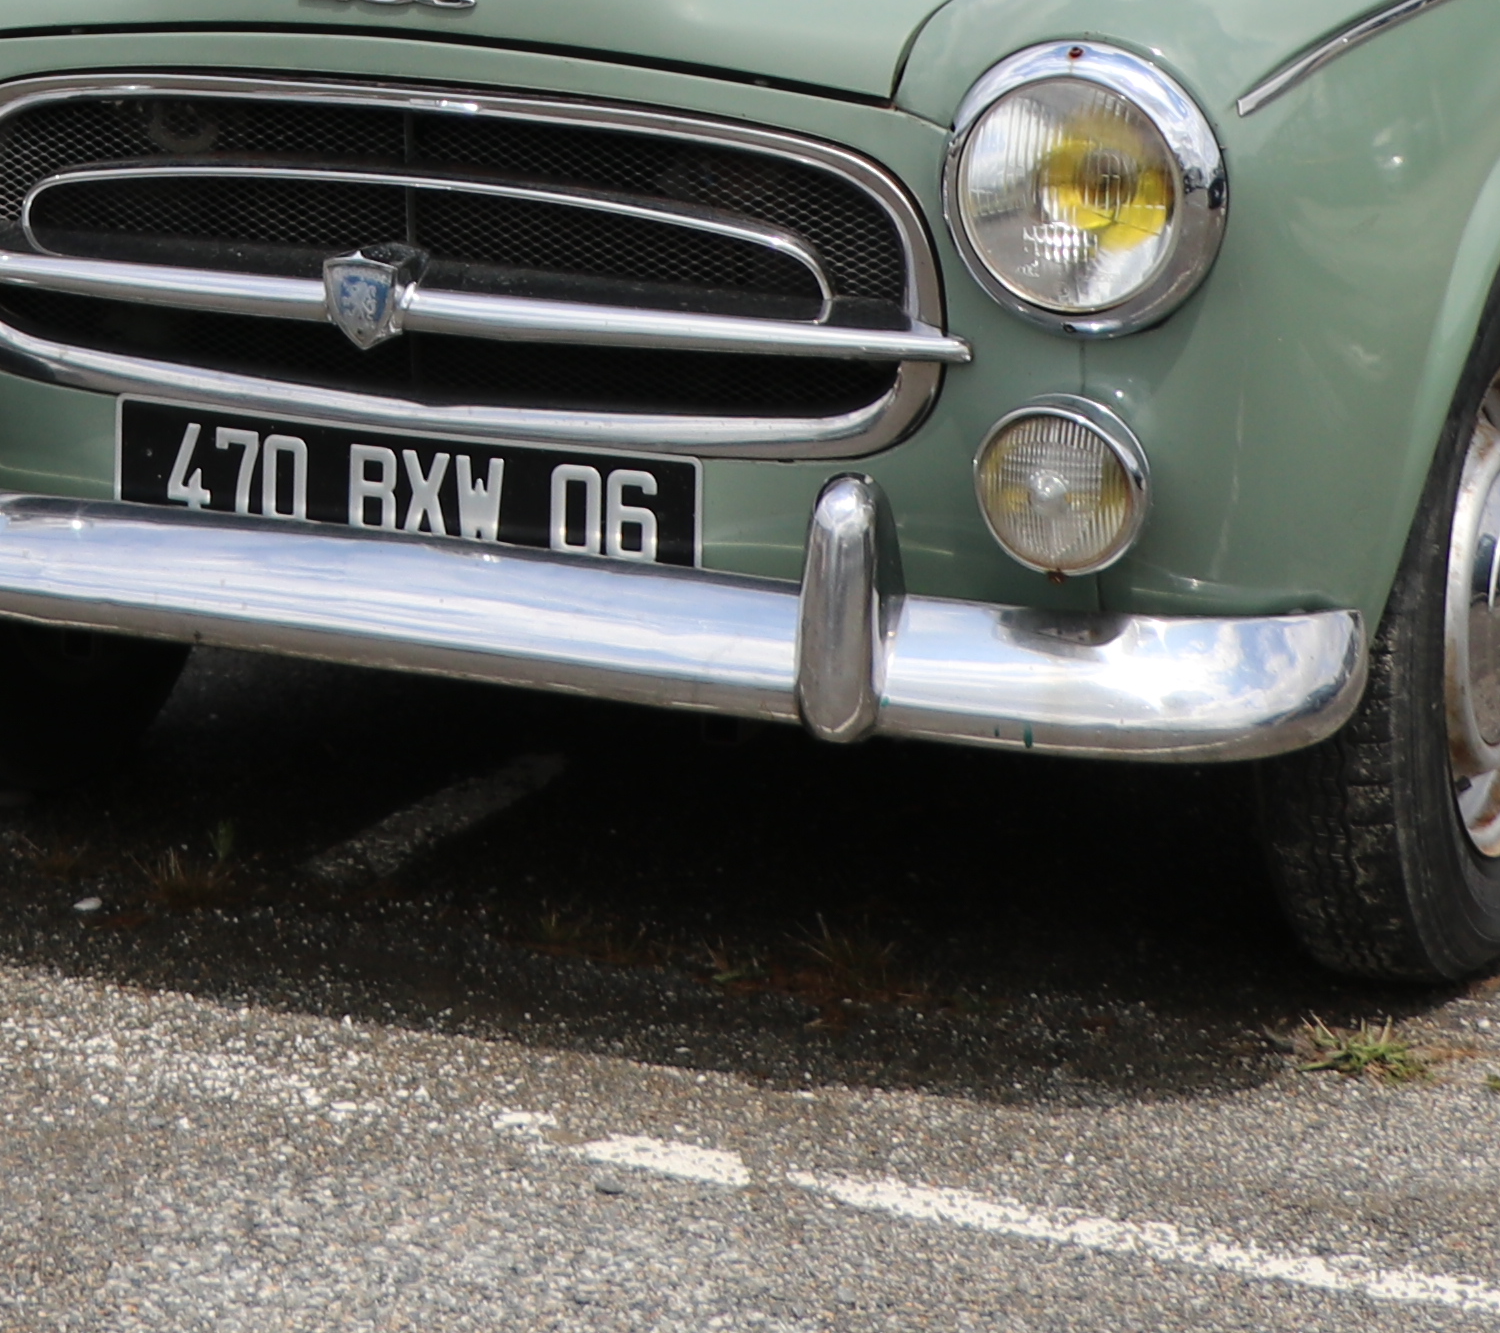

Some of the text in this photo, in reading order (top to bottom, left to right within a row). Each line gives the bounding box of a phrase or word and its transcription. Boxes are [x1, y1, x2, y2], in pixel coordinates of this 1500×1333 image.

[166, 422, 658, 562] 470 BXW 06
